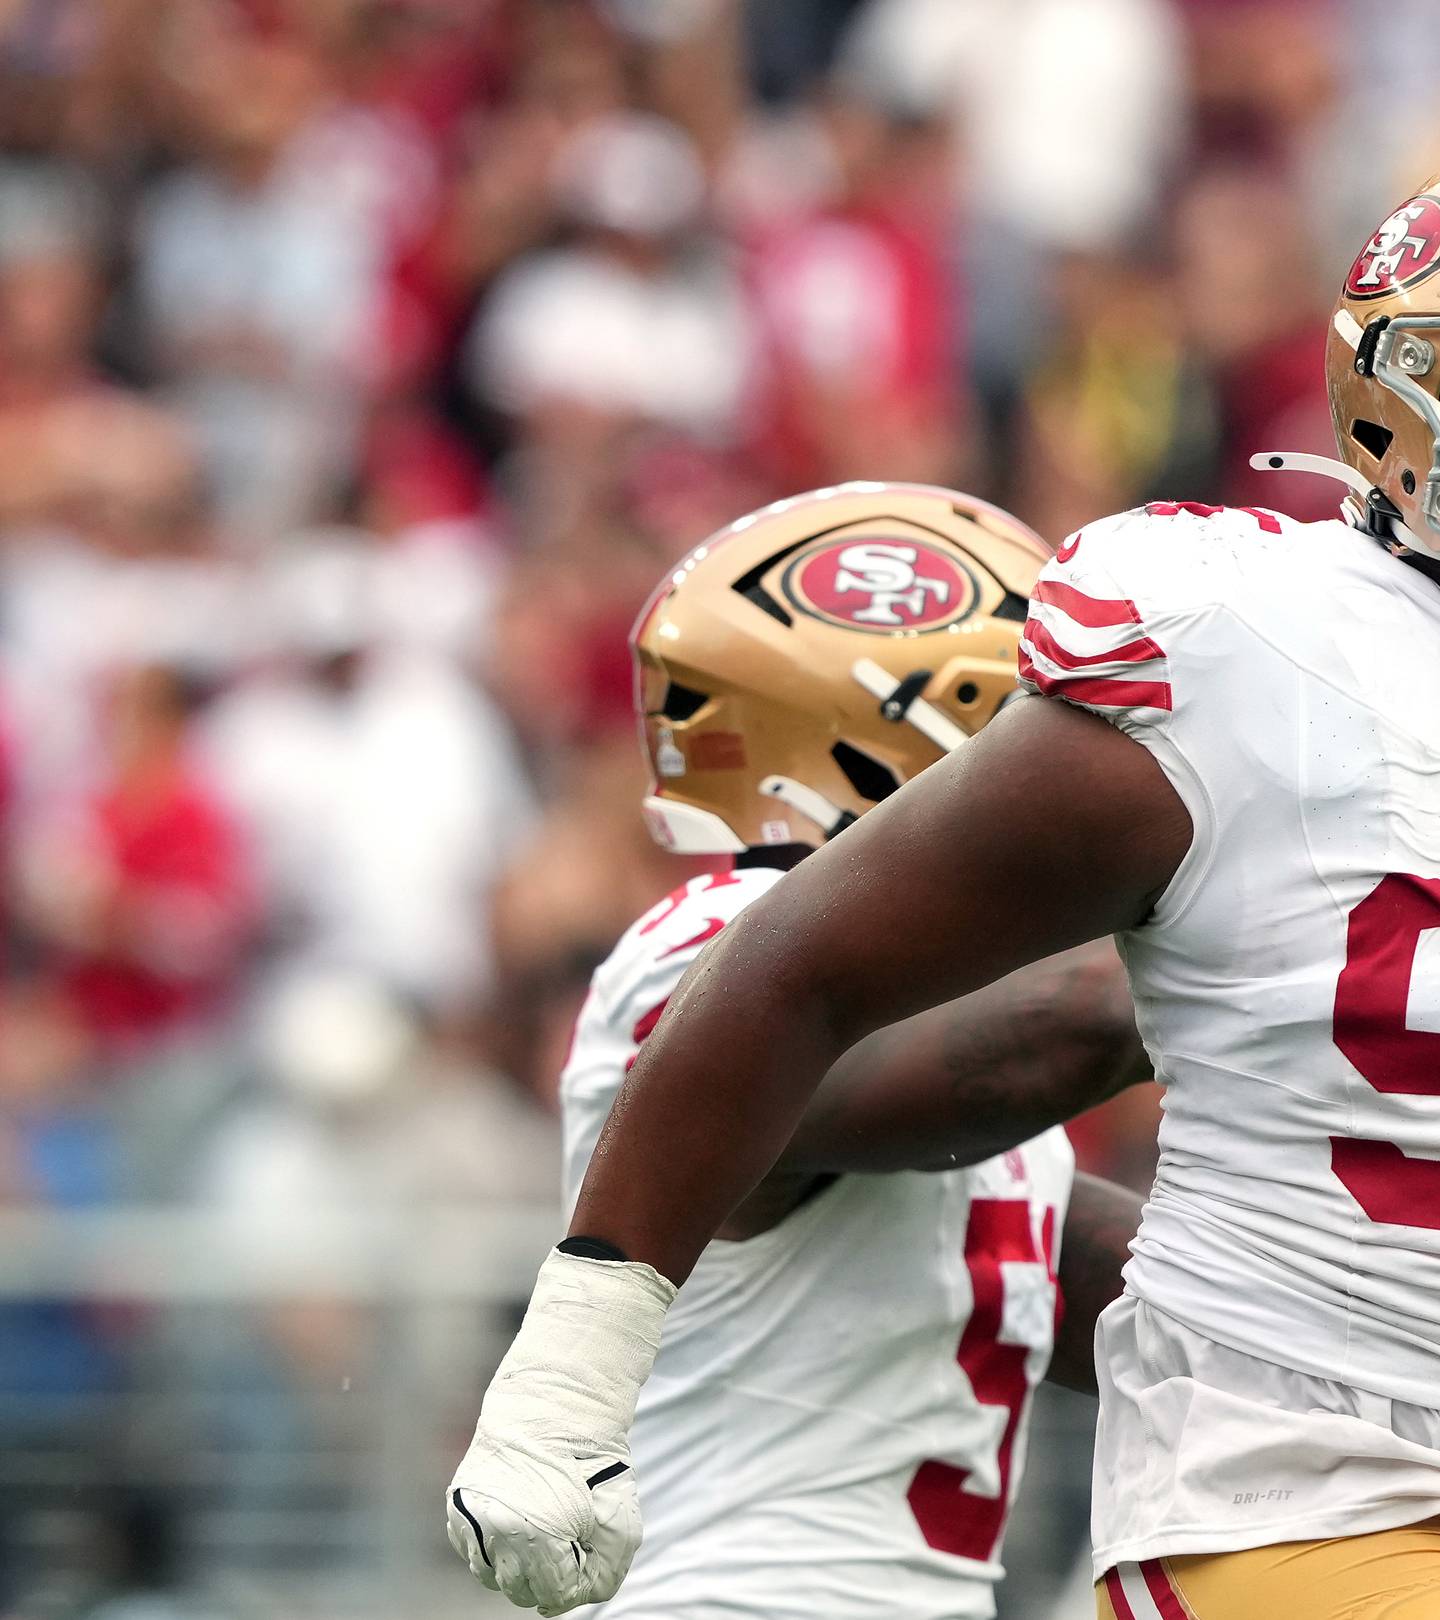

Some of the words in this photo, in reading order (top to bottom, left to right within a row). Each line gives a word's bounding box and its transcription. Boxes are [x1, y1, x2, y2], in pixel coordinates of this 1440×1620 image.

[1356, 204, 1428, 286] SF
[835, 544, 948, 624] SF
[1232, 1489, 1294, 1504] DRI-FIT
